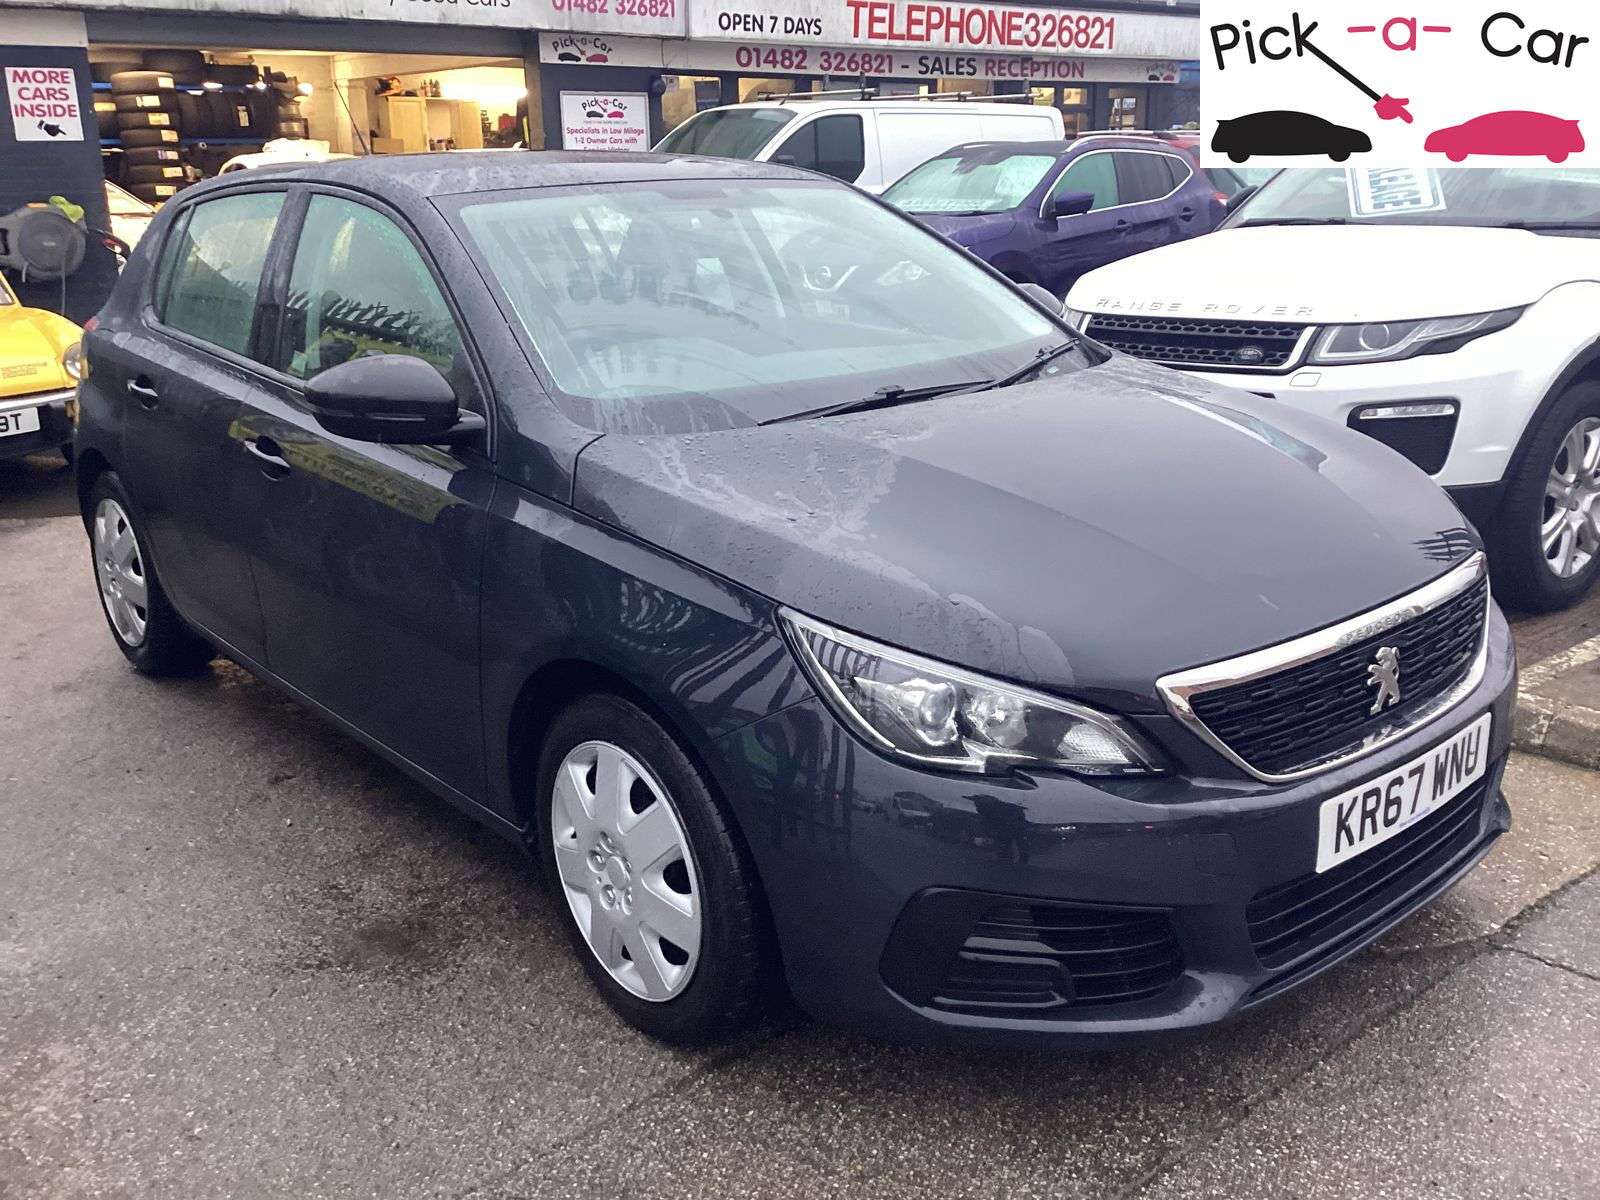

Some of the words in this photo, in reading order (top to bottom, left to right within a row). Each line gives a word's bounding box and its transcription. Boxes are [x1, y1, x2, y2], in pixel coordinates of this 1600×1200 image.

[616, 0, 675, 17] 326821
[718, 12, 764, 32] OPEN
[769, 15, 778, 33] 7
[784, 17, 822, 35] DAYS
[736, 47, 808, 70] 01482
[819, 51, 893, 73] 326821
[918, 56, 977, 76] SALES
[985, 58, 1085, 79] RECEPTION
[12, 70, 71, 84] MORE
[18, 87, 70, 101] CARS
[14, 104, 78, 117] INSIDE
[566, 127, 600, 135] Specialists
[1096, 298, 1183, 312] RANGE
[1203, 302, 1314, 317] ROVER
[1334, 762, 1425, 854] KR67
[1432, 726, 1482, 801] WNU
